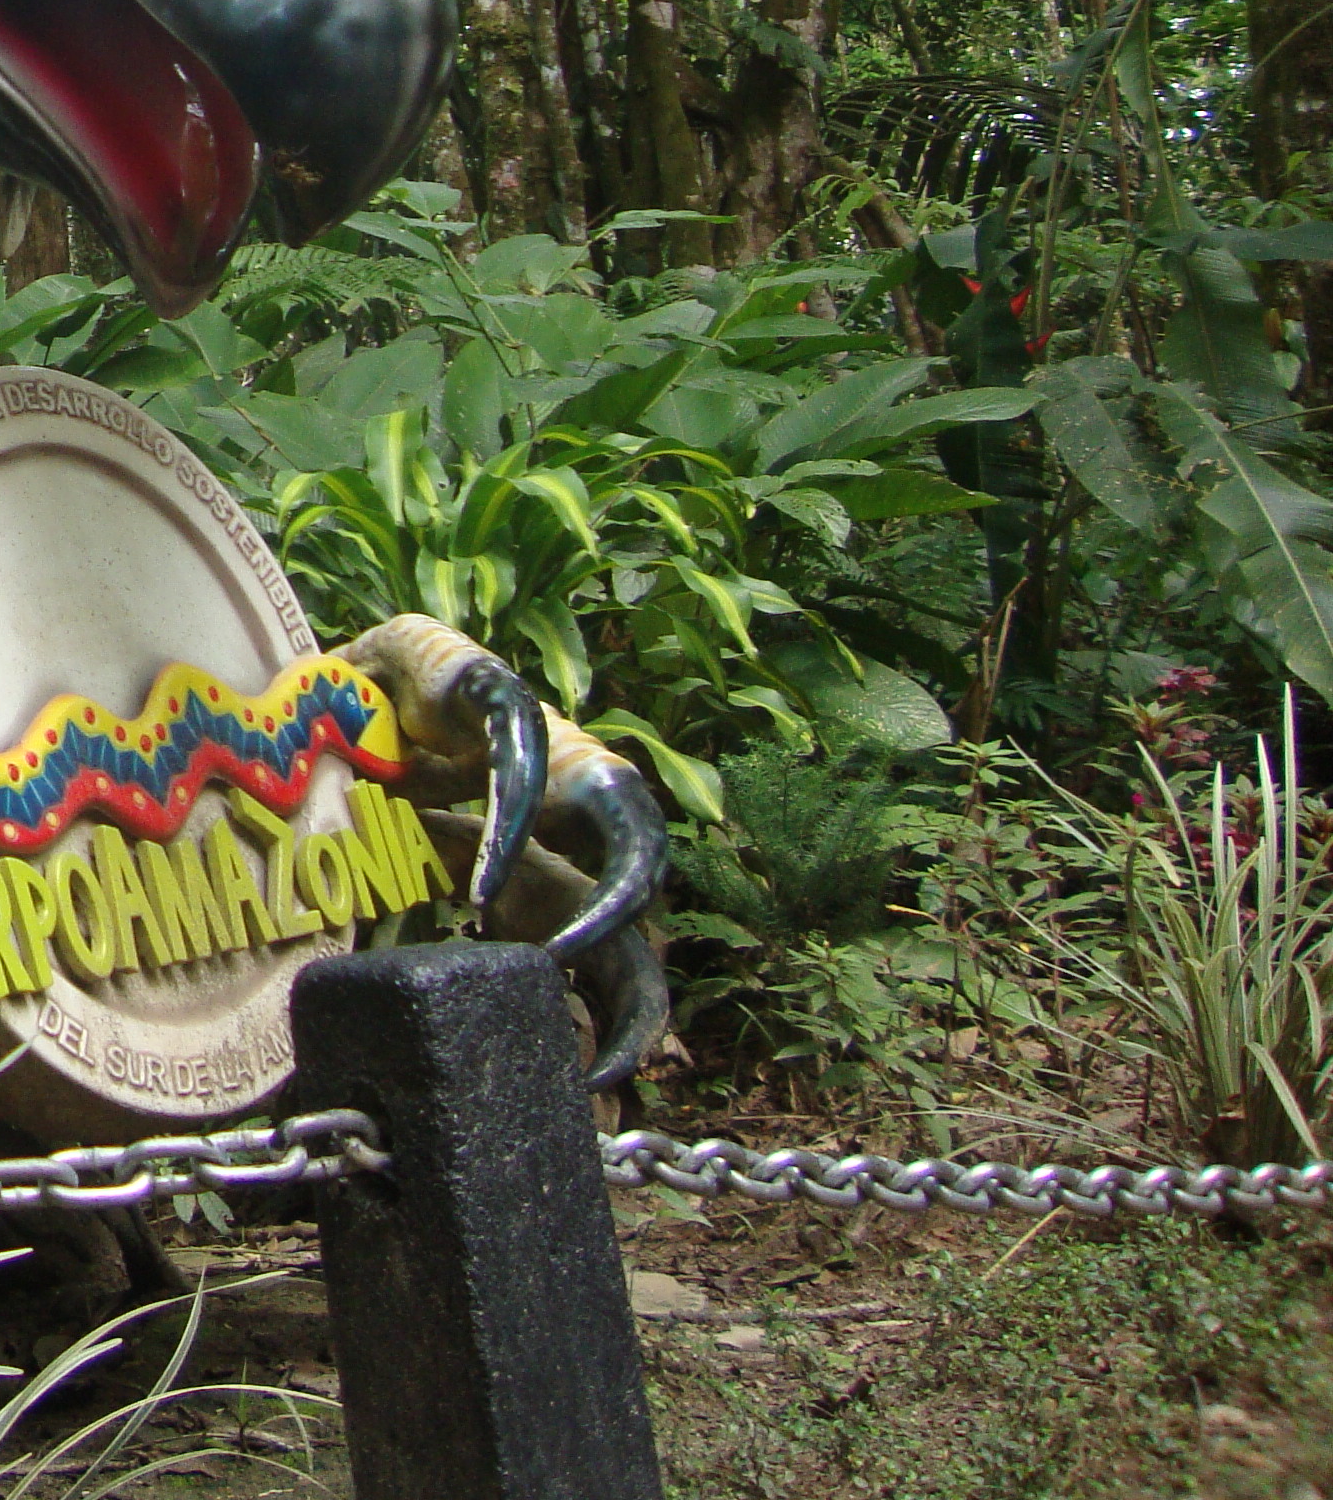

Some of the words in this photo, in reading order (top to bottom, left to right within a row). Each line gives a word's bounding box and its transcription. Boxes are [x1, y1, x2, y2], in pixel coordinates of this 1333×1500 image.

[1, 380, 175, 467] DESARROLLO
[175, 455, 313, 656] SOSTENIBLE
[38, 999, 96, 1068] DEL
[103, 1044, 169, 1094] SUR
[172, 1057, 213, 1097] DE
